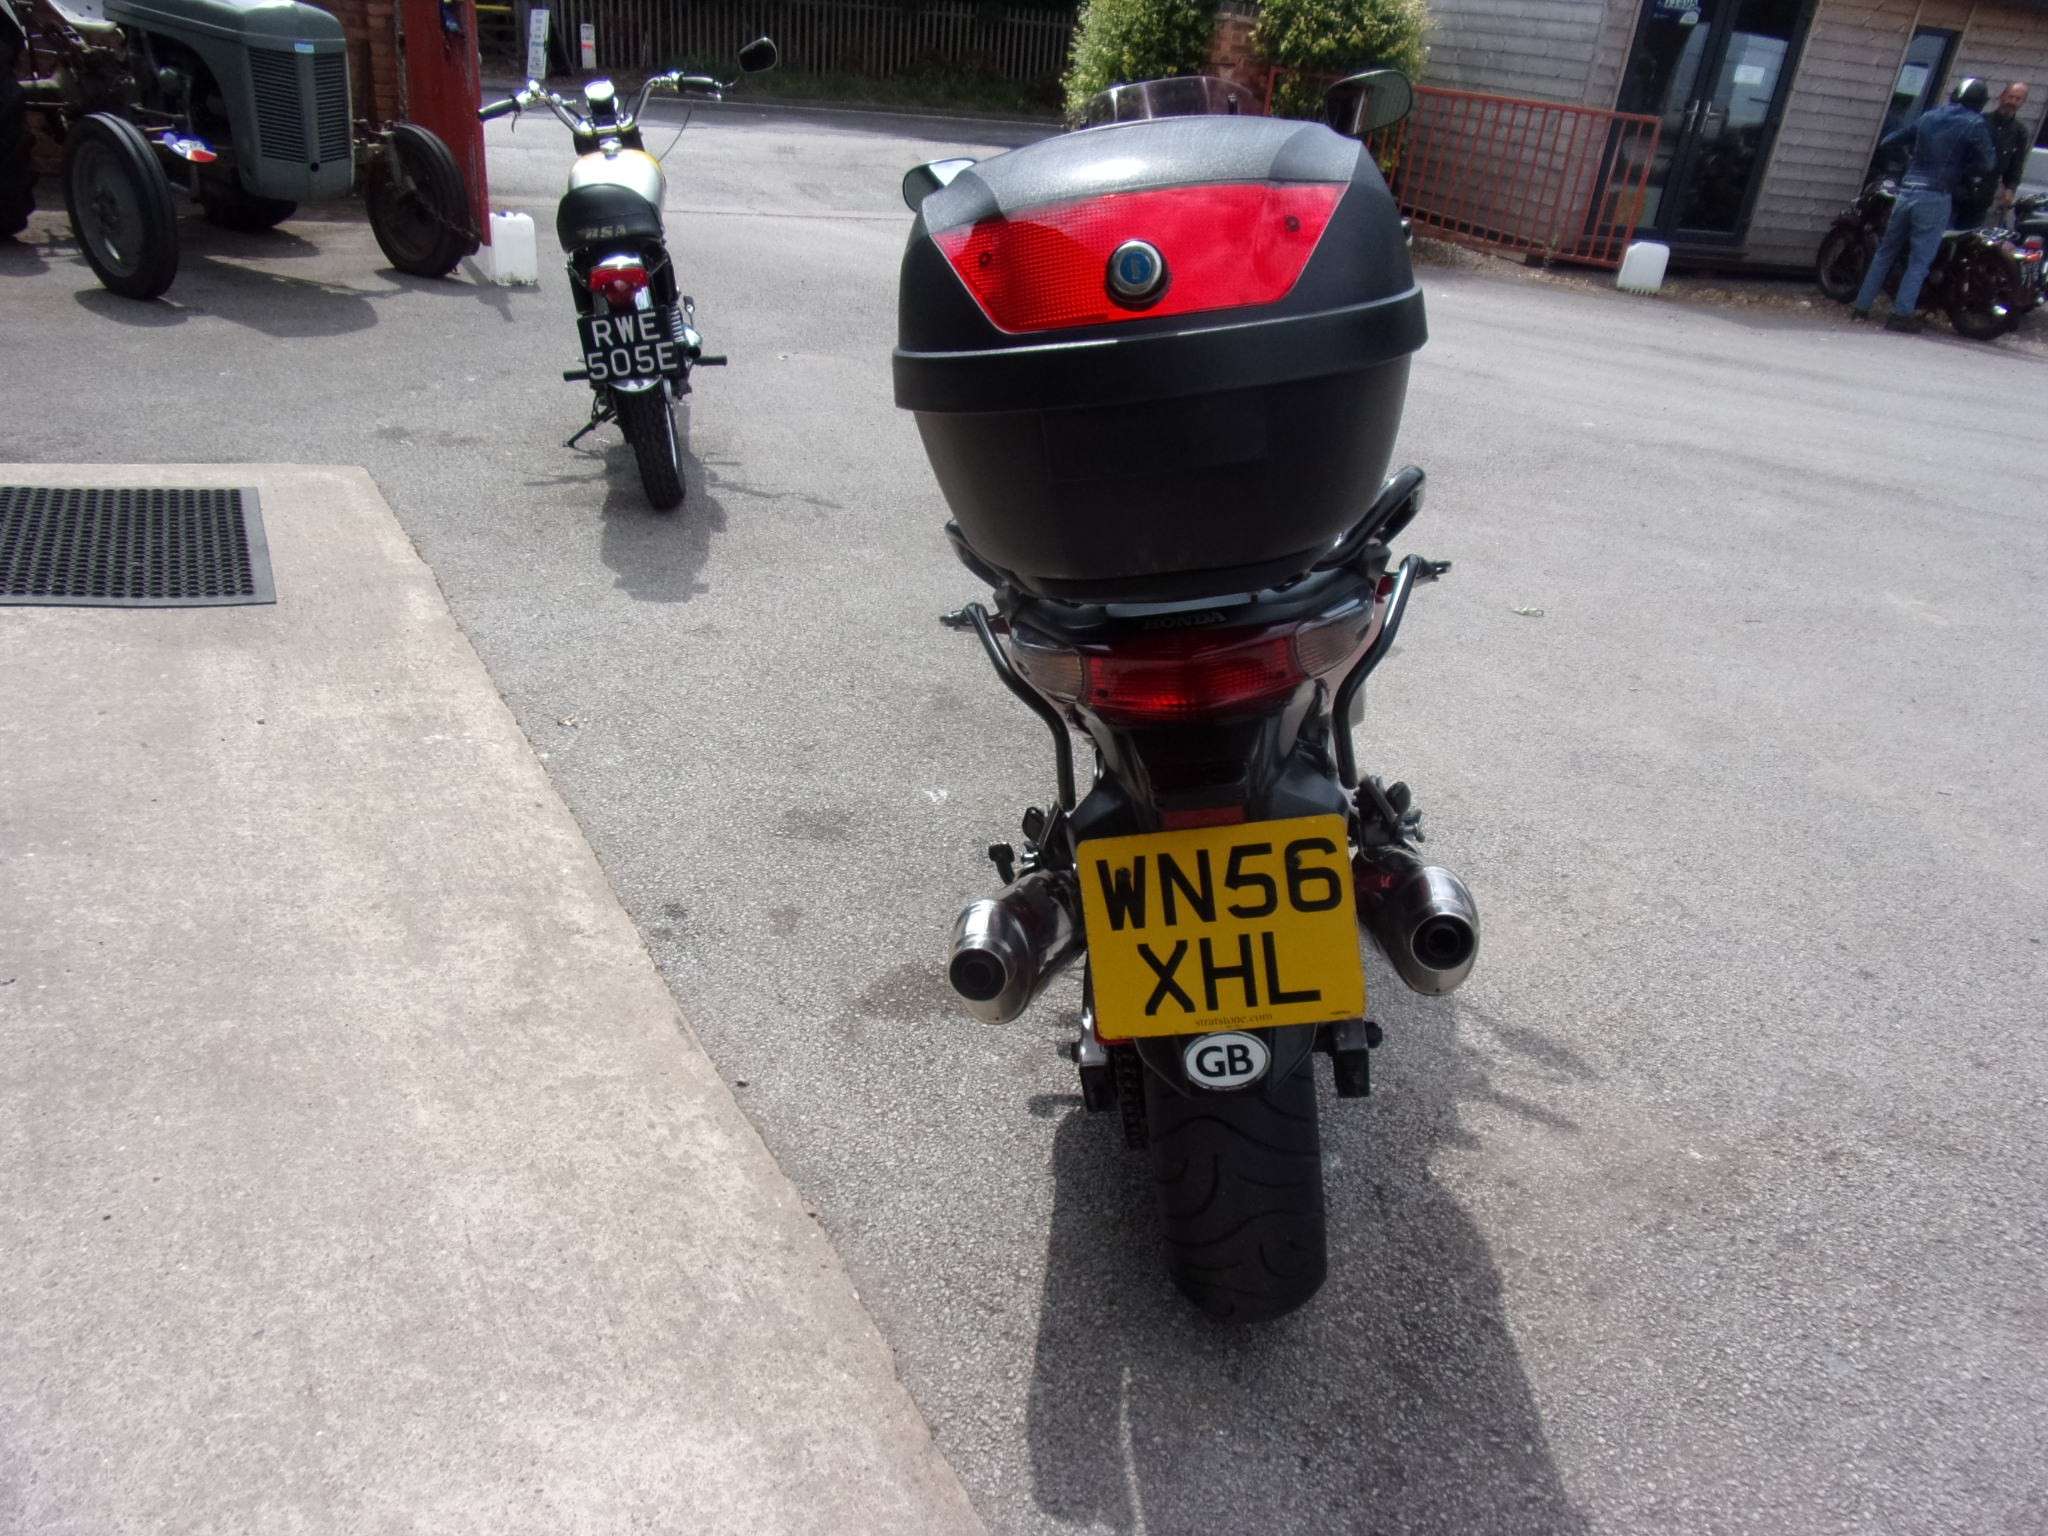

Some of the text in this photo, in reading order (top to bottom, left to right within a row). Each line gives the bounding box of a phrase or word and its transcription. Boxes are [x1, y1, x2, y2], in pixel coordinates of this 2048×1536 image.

[591, 311, 661, 348] RWE
[587, 341, 678, 380] 505E
[1143, 612, 1228, 630] HONDA
[1096, 837, 1343, 931] WN56
[1137, 931, 1322, 1016] XHL
[1195, 1044, 1254, 1077] GB
